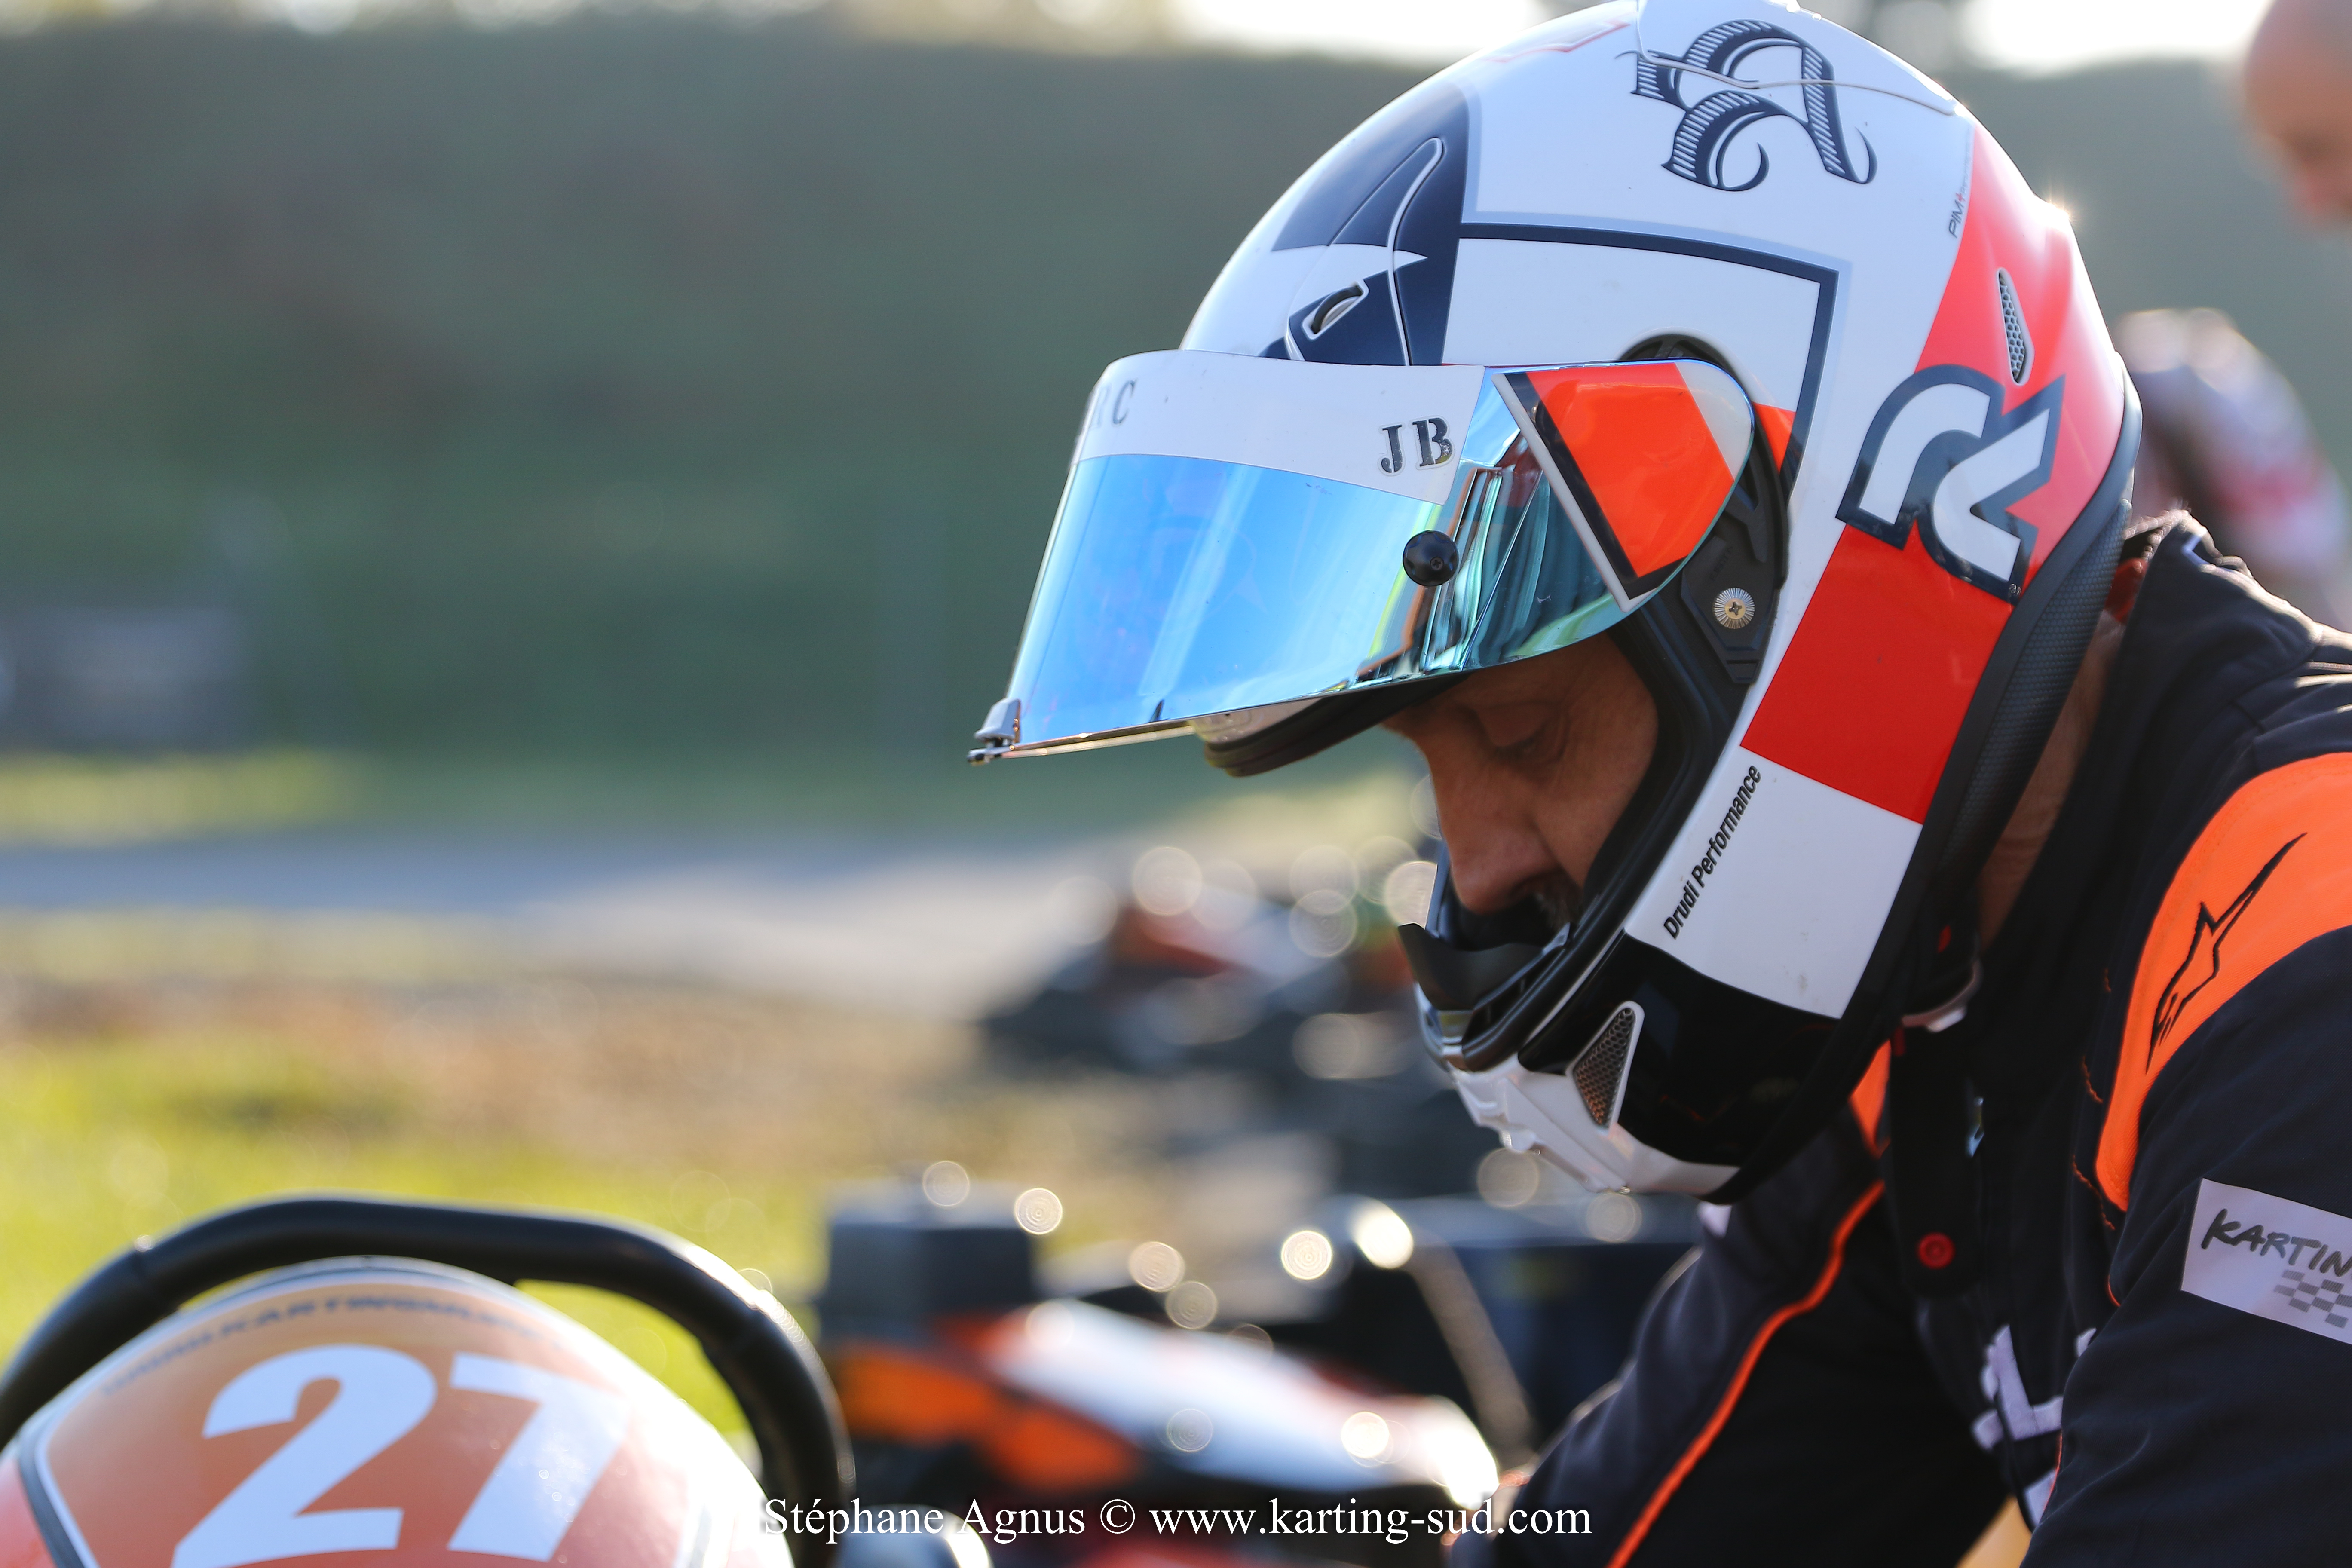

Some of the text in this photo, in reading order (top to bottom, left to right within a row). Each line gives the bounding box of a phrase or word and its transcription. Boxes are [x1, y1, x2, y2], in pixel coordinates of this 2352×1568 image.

[1663, 765, 1761, 940] Drudi Performance
[2201, 1208, 2352, 1280] KARTIN
[171, 1344, 636, 1568] 27
